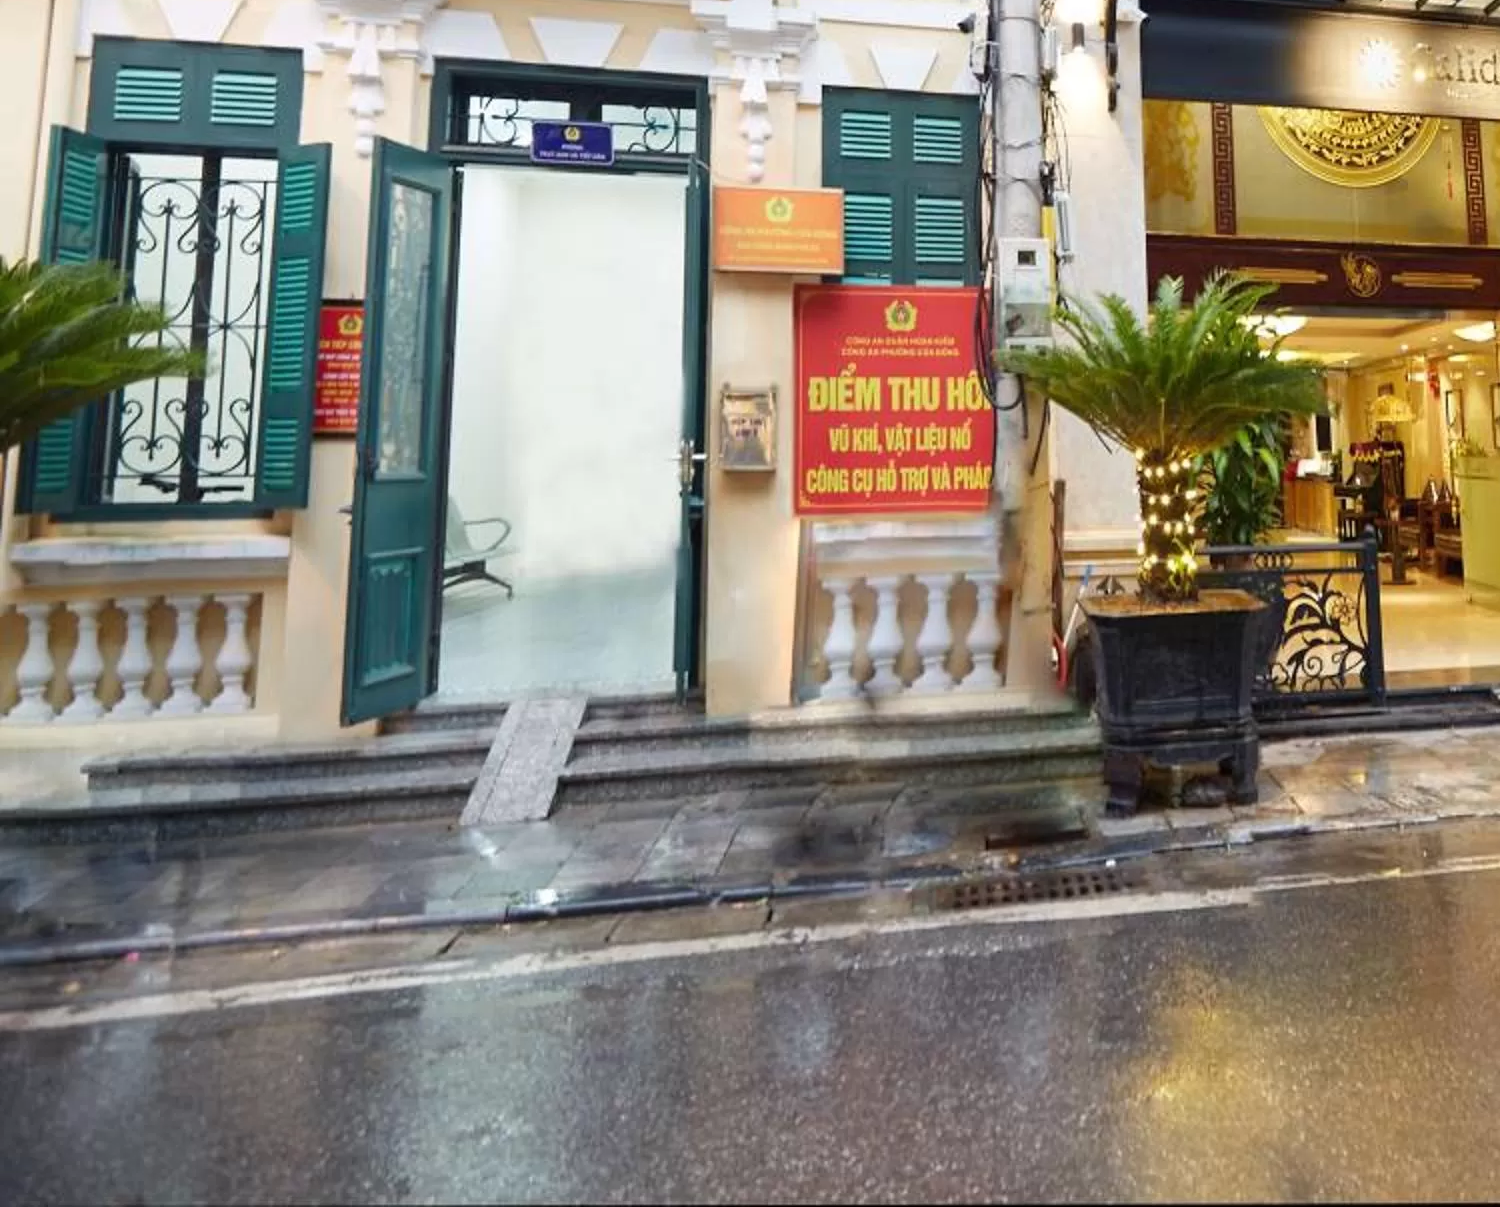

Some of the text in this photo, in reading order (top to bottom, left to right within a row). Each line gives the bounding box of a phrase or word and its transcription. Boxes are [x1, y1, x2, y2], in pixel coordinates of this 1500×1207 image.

[808, 362, 881, 412] ĐIỂM
[887, 376, 940, 412] THU
[829, 423, 849, 453] VŨ
[885, 422, 913, 457] VẬT
[916, 422, 947, 457] LIỆU
[806, 464, 849, 493] CÔNG
[852, 468, 873, 498] CỤ
[900, 464, 929, 497] TRỢ
[931, 461, 951, 491] VÀ
